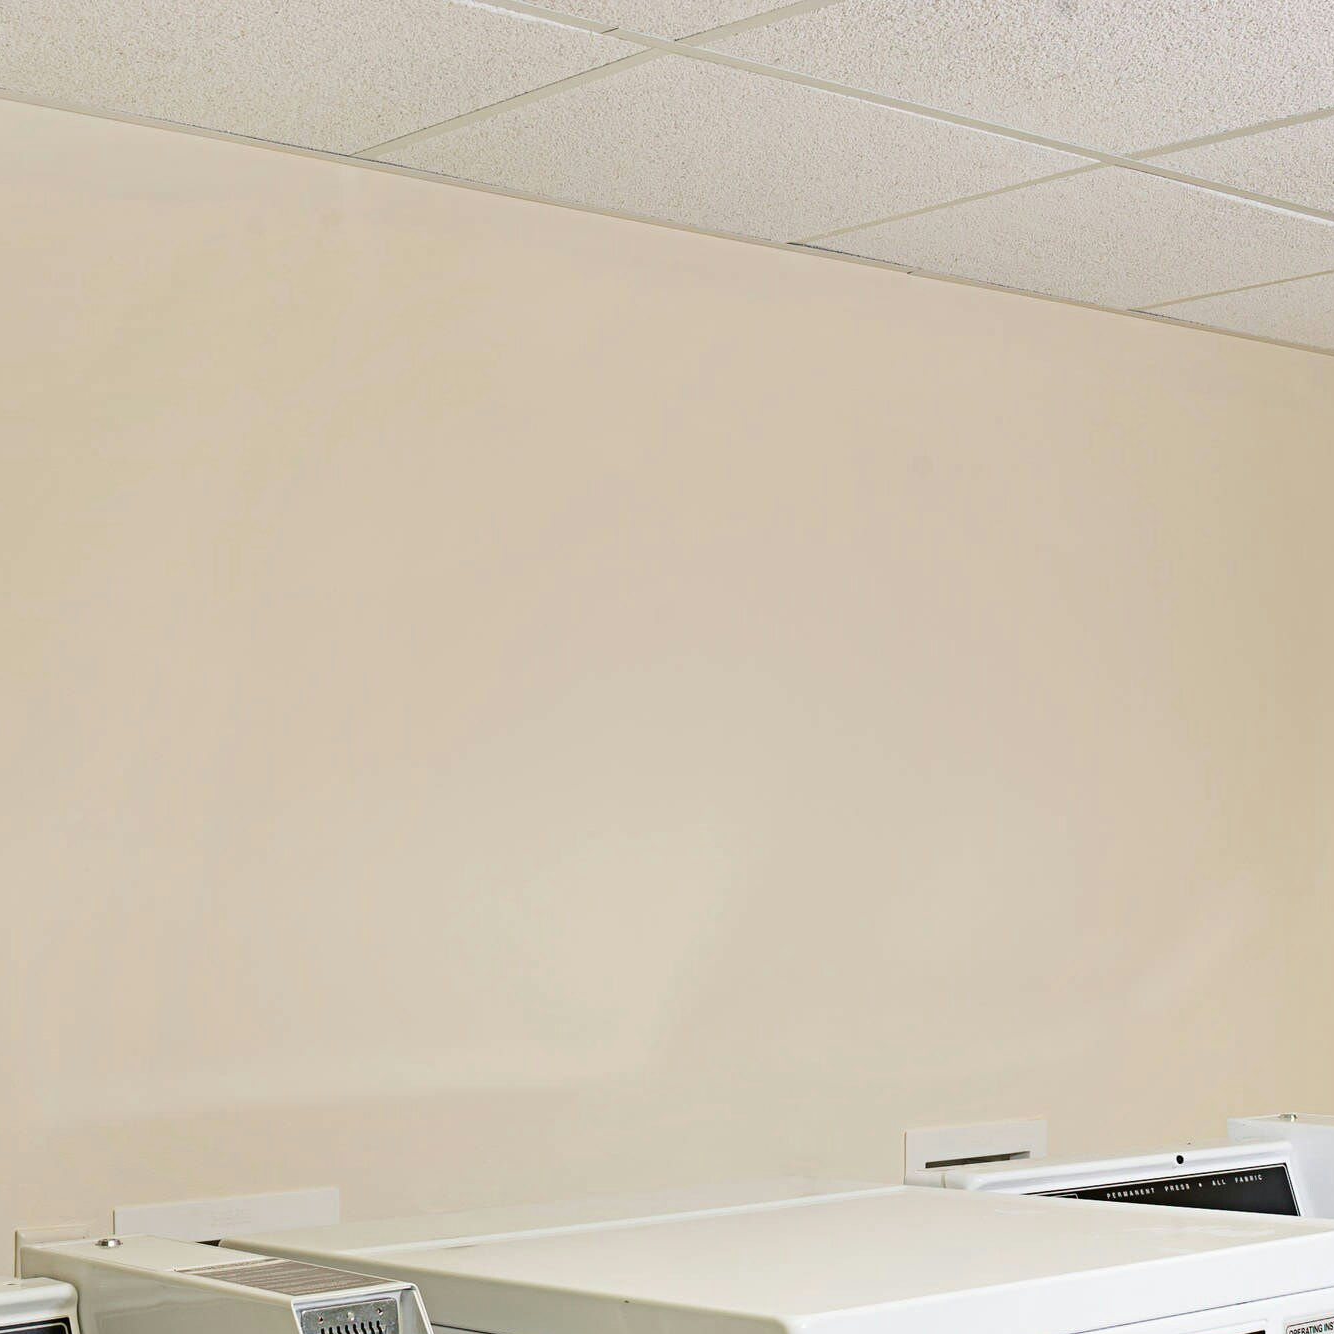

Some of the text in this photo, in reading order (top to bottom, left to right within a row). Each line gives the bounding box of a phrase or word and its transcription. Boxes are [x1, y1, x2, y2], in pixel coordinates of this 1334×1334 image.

[1107, 1174, 1263, 1200] PERMANENT PRESS ALL FABRIC
